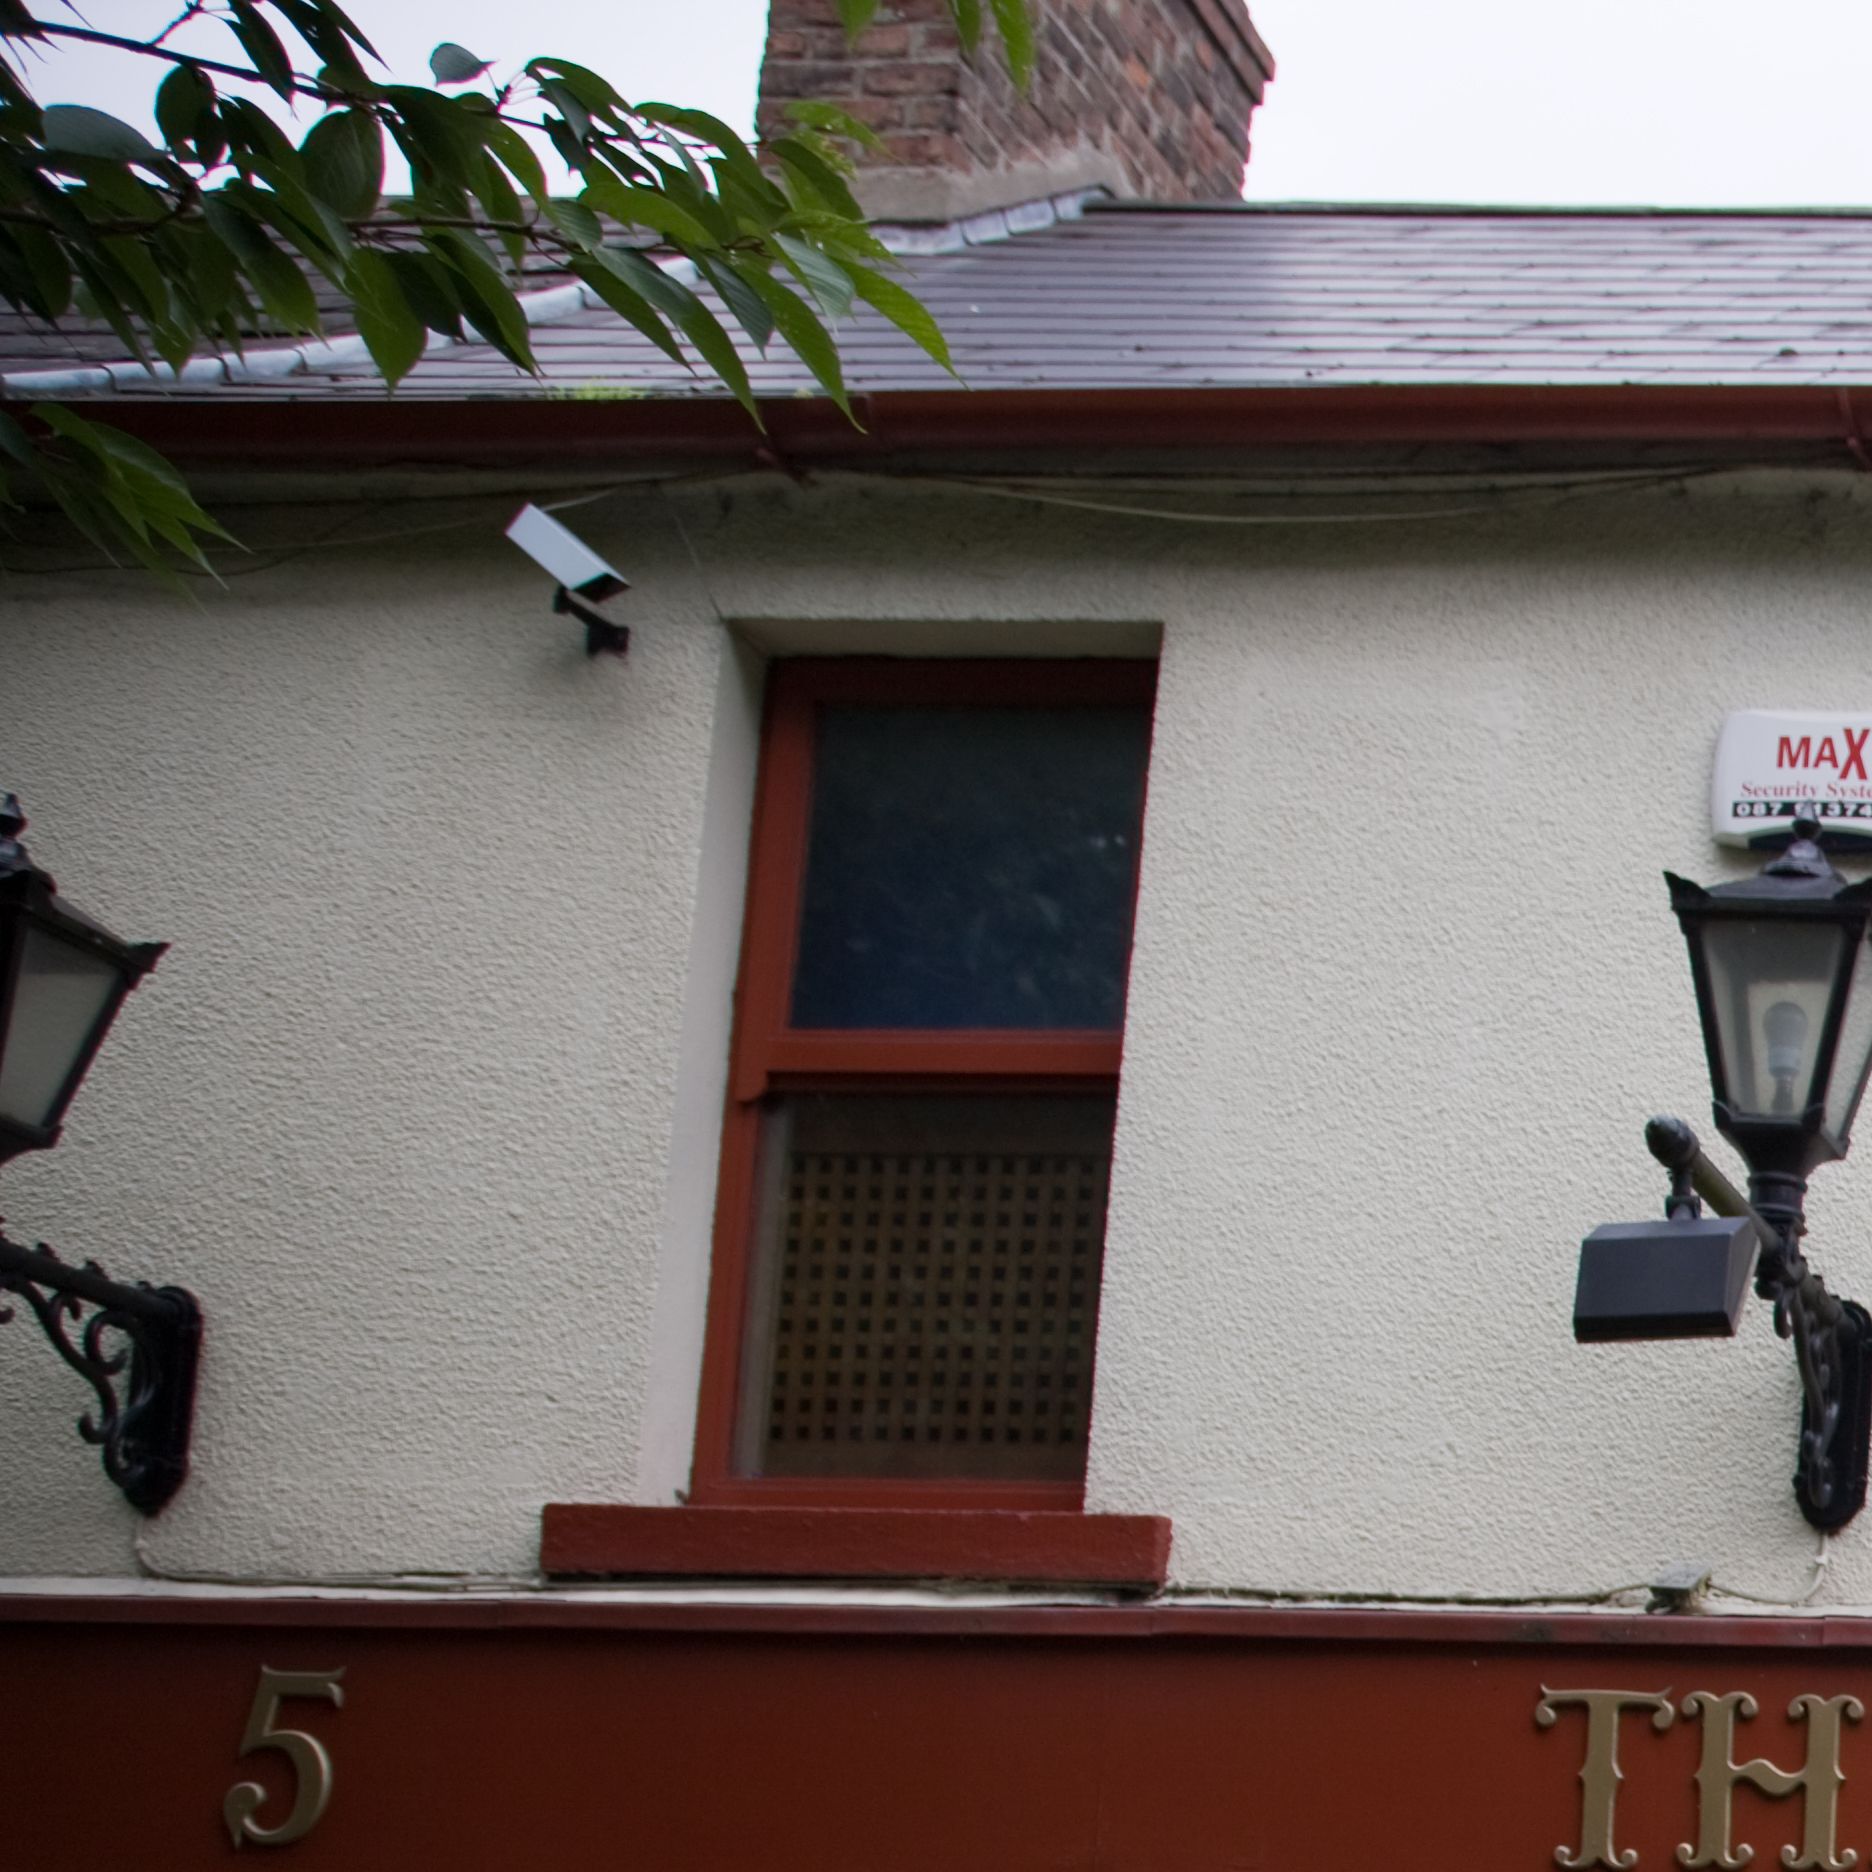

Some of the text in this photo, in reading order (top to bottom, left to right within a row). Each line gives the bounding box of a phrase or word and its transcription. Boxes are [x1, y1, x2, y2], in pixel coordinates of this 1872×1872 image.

[1776, 727, 1871, 781] MAX
[1740, 782, 1820, 799] Security
[1736, 802, 1783, 817] 087
[223, 1664, 347, 1849] 5
